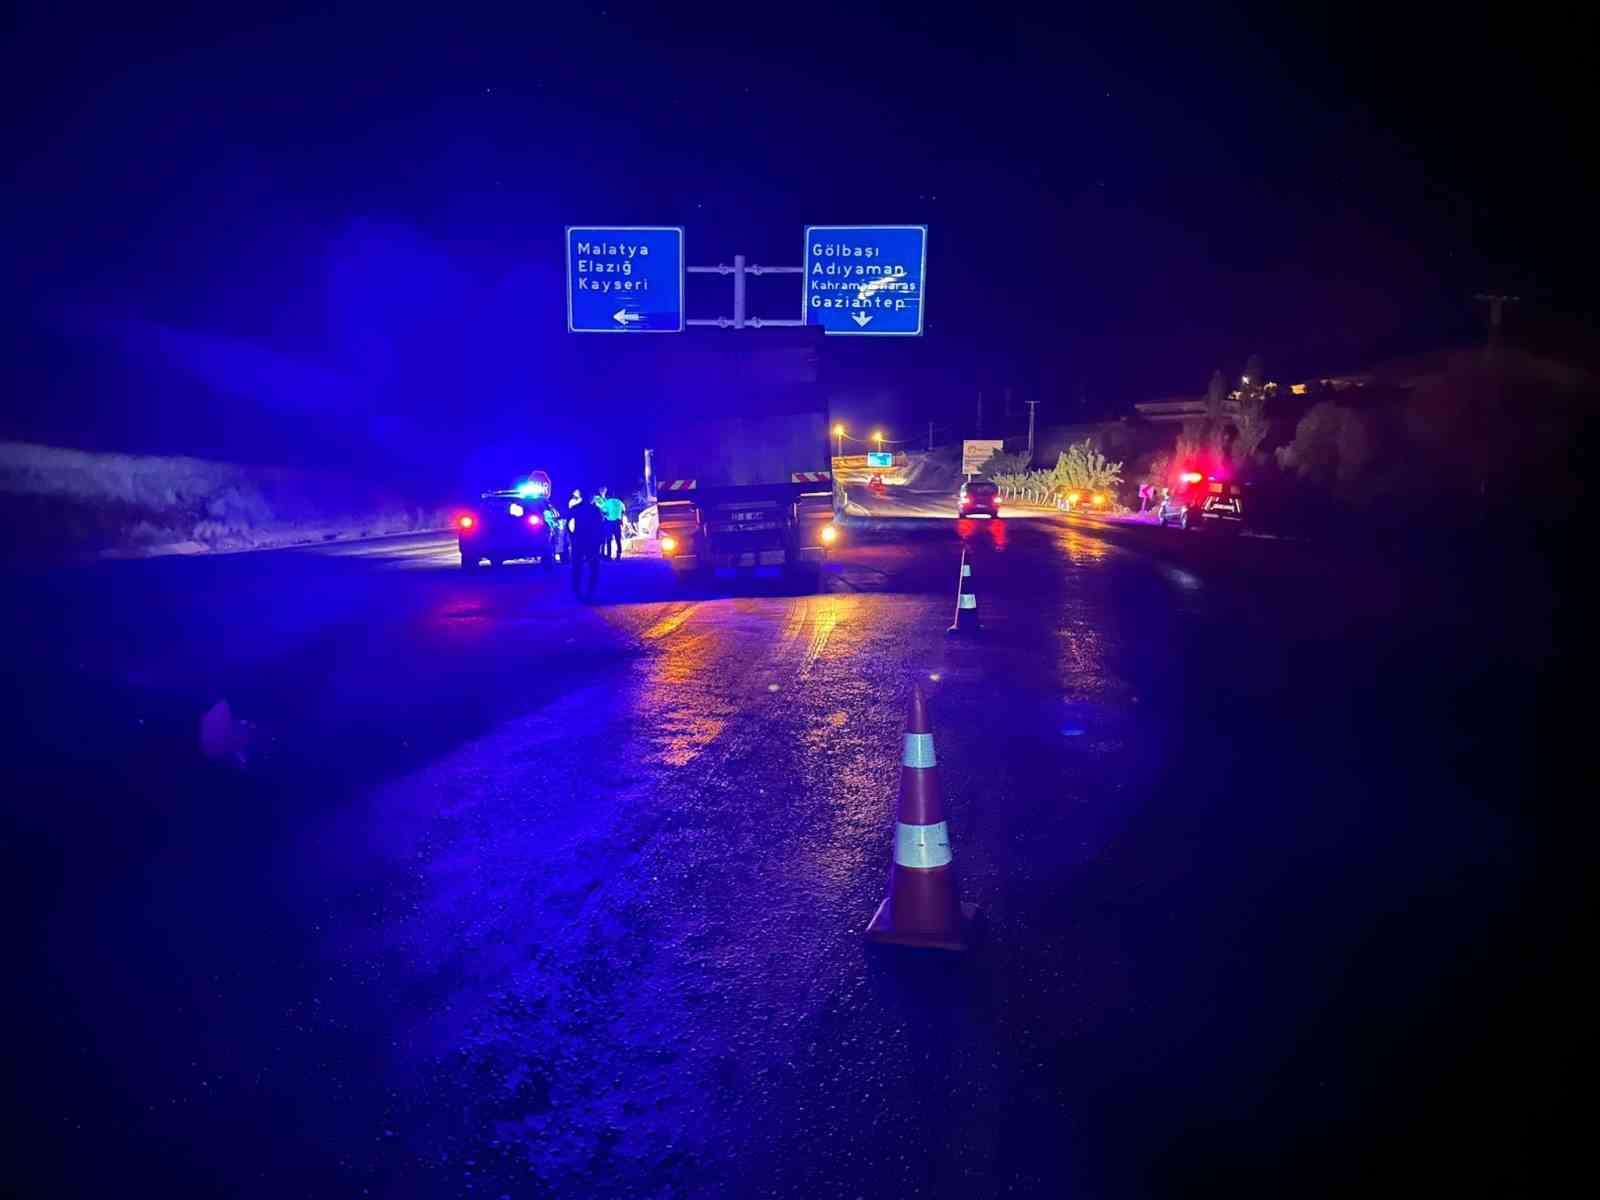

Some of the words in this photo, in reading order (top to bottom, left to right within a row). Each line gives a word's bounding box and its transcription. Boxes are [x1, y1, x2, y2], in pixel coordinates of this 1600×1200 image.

[578, 242, 649, 258] Malatya
[812, 243, 879, 258] Gölbaşı
[578, 260, 632, 275] Elazığ
[812, 262, 904, 278] Adıyaman
[578, 277, 648, 293] Kayseri
[811, 295, 905, 312] Gaziantep
